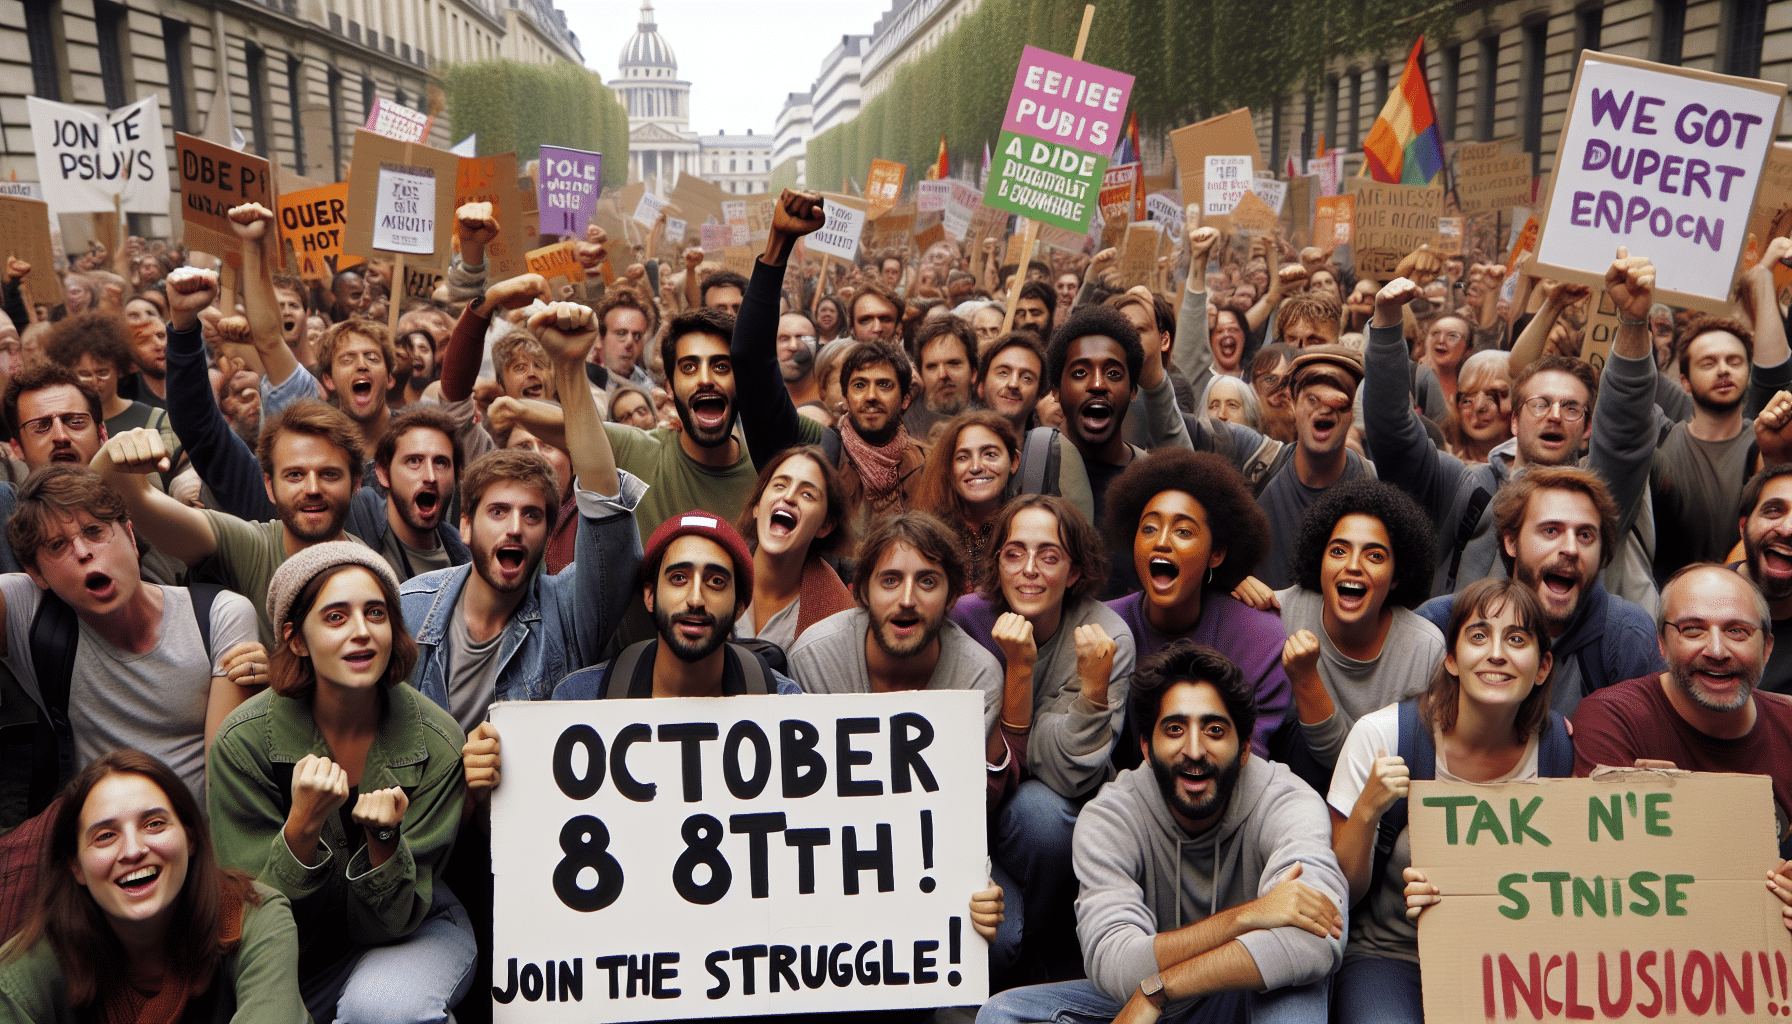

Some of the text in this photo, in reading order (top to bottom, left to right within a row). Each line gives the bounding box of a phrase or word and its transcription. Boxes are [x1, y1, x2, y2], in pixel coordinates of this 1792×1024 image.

[1590, 87, 1763, 150] WE GOT
[1581, 138, 1746, 203] DUPERT
[553, 712, 940, 802] OCTOBER
[1422, 796, 1552, 847] TAK
[552, 814, 625, 912] 8
[1497, 870, 1696, 920] STNISE
[491, 916, 962, 1004] JOIN THE STRUGGLE!
[1481, 948, 1791, 1021] INCLUSION!!
